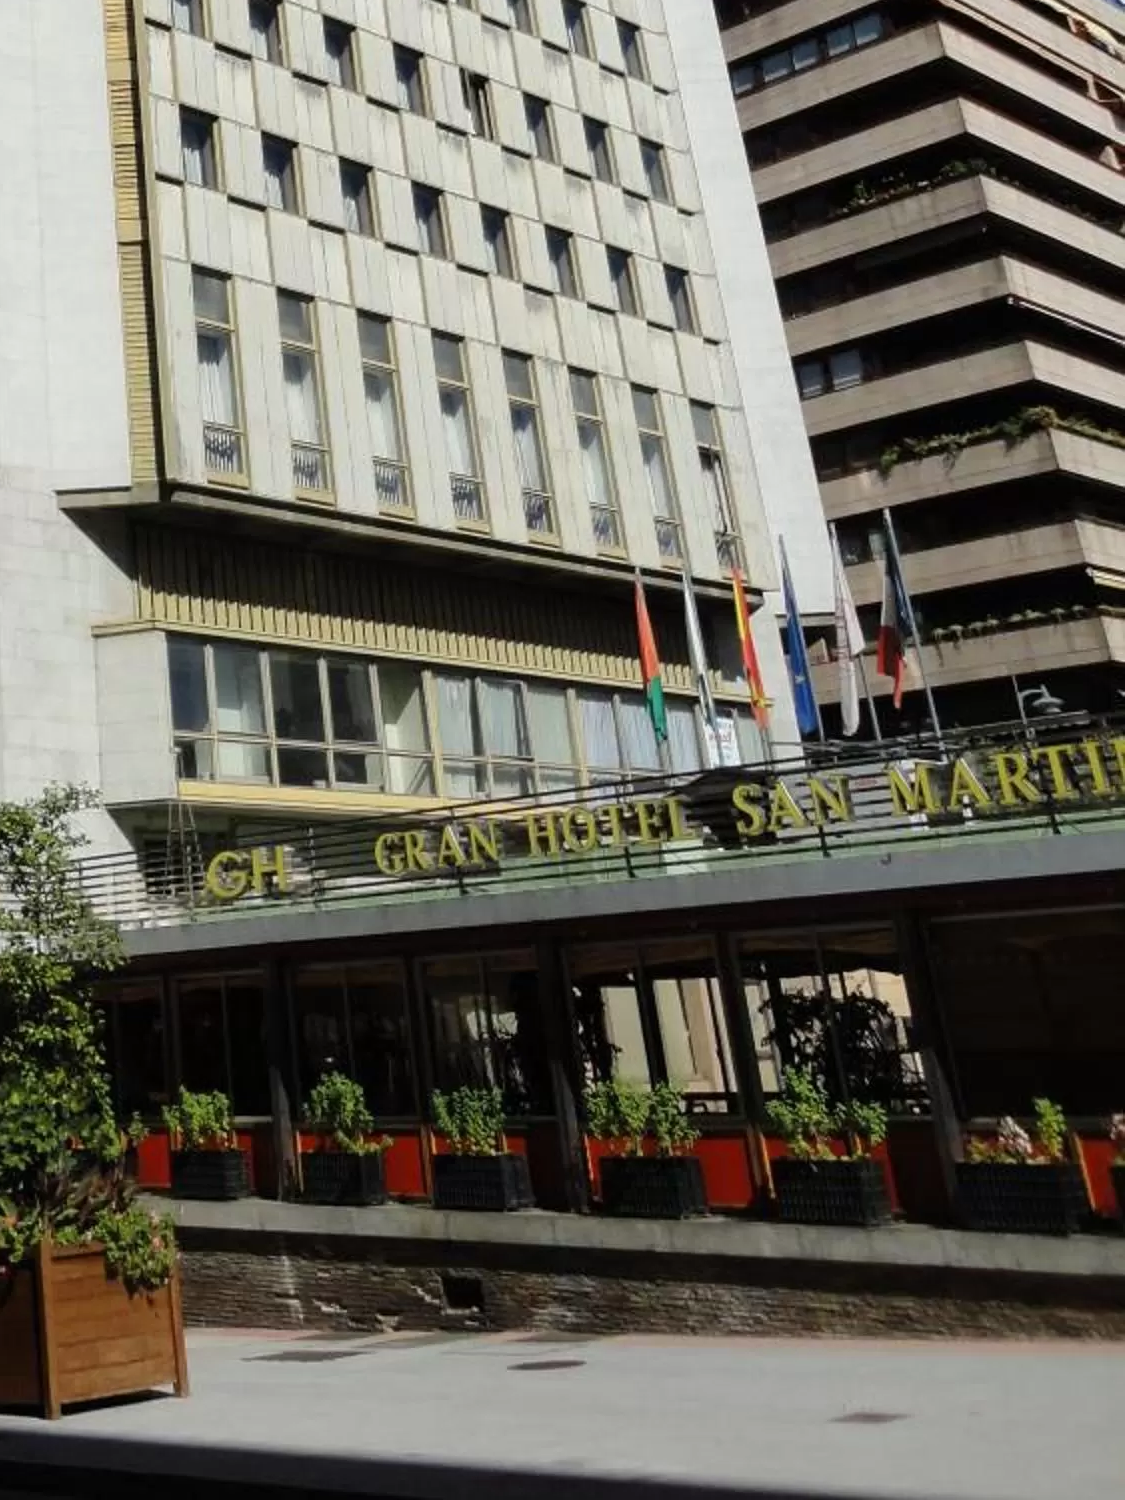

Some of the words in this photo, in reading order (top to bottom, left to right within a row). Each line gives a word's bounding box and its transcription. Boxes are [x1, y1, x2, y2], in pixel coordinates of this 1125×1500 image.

[374, 816, 502, 875] GRAN
[526, 798, 697, 858] HOTEL
[732, 772, 854, 837] SAN
[888, 736, 1125, 818] MARTI
[205, 844, 287, 898] GH
